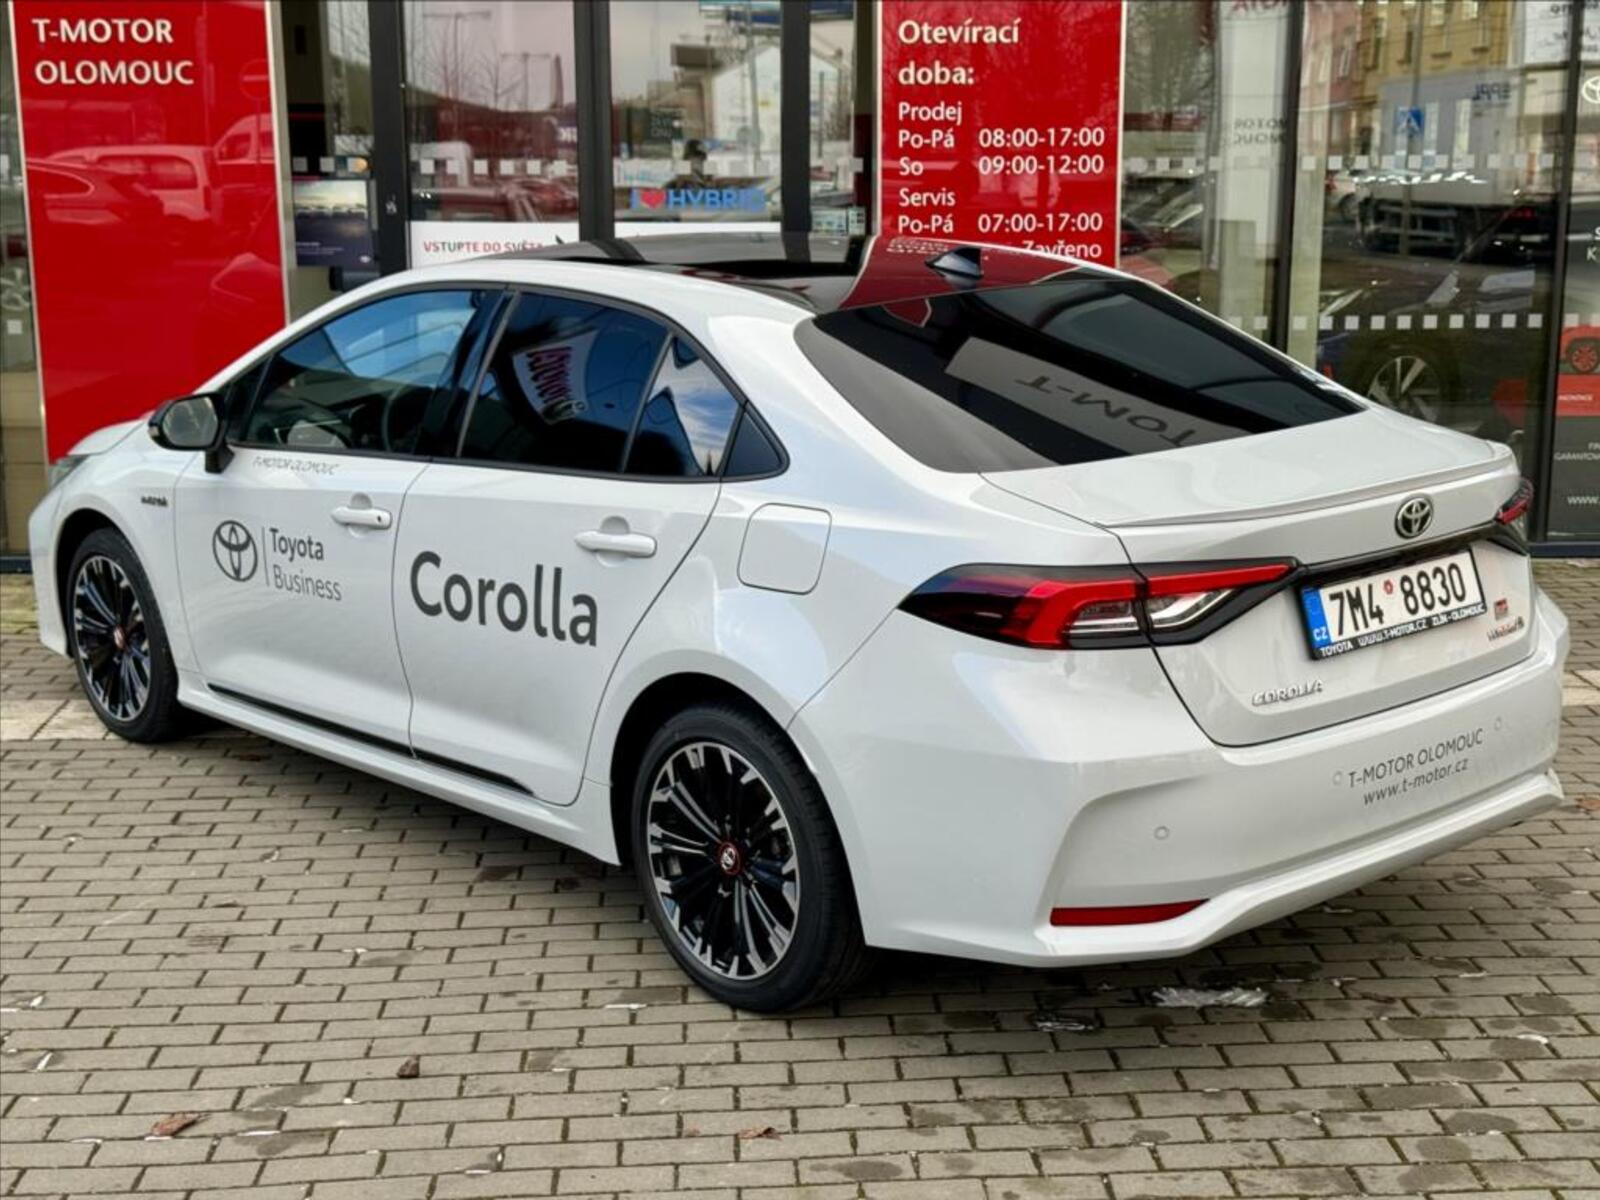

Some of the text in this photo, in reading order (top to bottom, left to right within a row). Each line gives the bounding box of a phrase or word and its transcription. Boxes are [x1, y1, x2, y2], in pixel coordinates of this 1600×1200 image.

[31, 18, 174, 43] T-MOTOR
[898, 17, 1022, 44] Otevírací
[35, 60, 195, 85] OLOMOUC
[898, 60, 975, 85] doba:
[898, 101, 962, 126] Prodej
[898, 127, 1105, 149] Po-Pá 08:00-17:00
[899, 155, 1104, 176] So 09:00-12:00
[899, 187, 956, 207] Servis
[898, 212, 1103, 234] Po-Pá 07:00-17:00
[423, 241, 481, 253] VSTUPTE
[483, 241, 502, 253] DO
[269, 528, 324, 562] Toyota
[273, 564, 342, 601] Business
[410, 551, 598, 647] Corolla
[1329, 584, 1384, 636] 7M4
[1400, 562, 1467, 615] 8830
[1313, 626, 1329, 641] CZ
[1320, 640, 1354, 657] TOYOTA
[1251, 679, 1324, 707] COROLLA
[1348, 728, 1484, 788] T-MOTOR OLOMOUC
[1363, 758, 1469, 806] www.t-motor.cz
